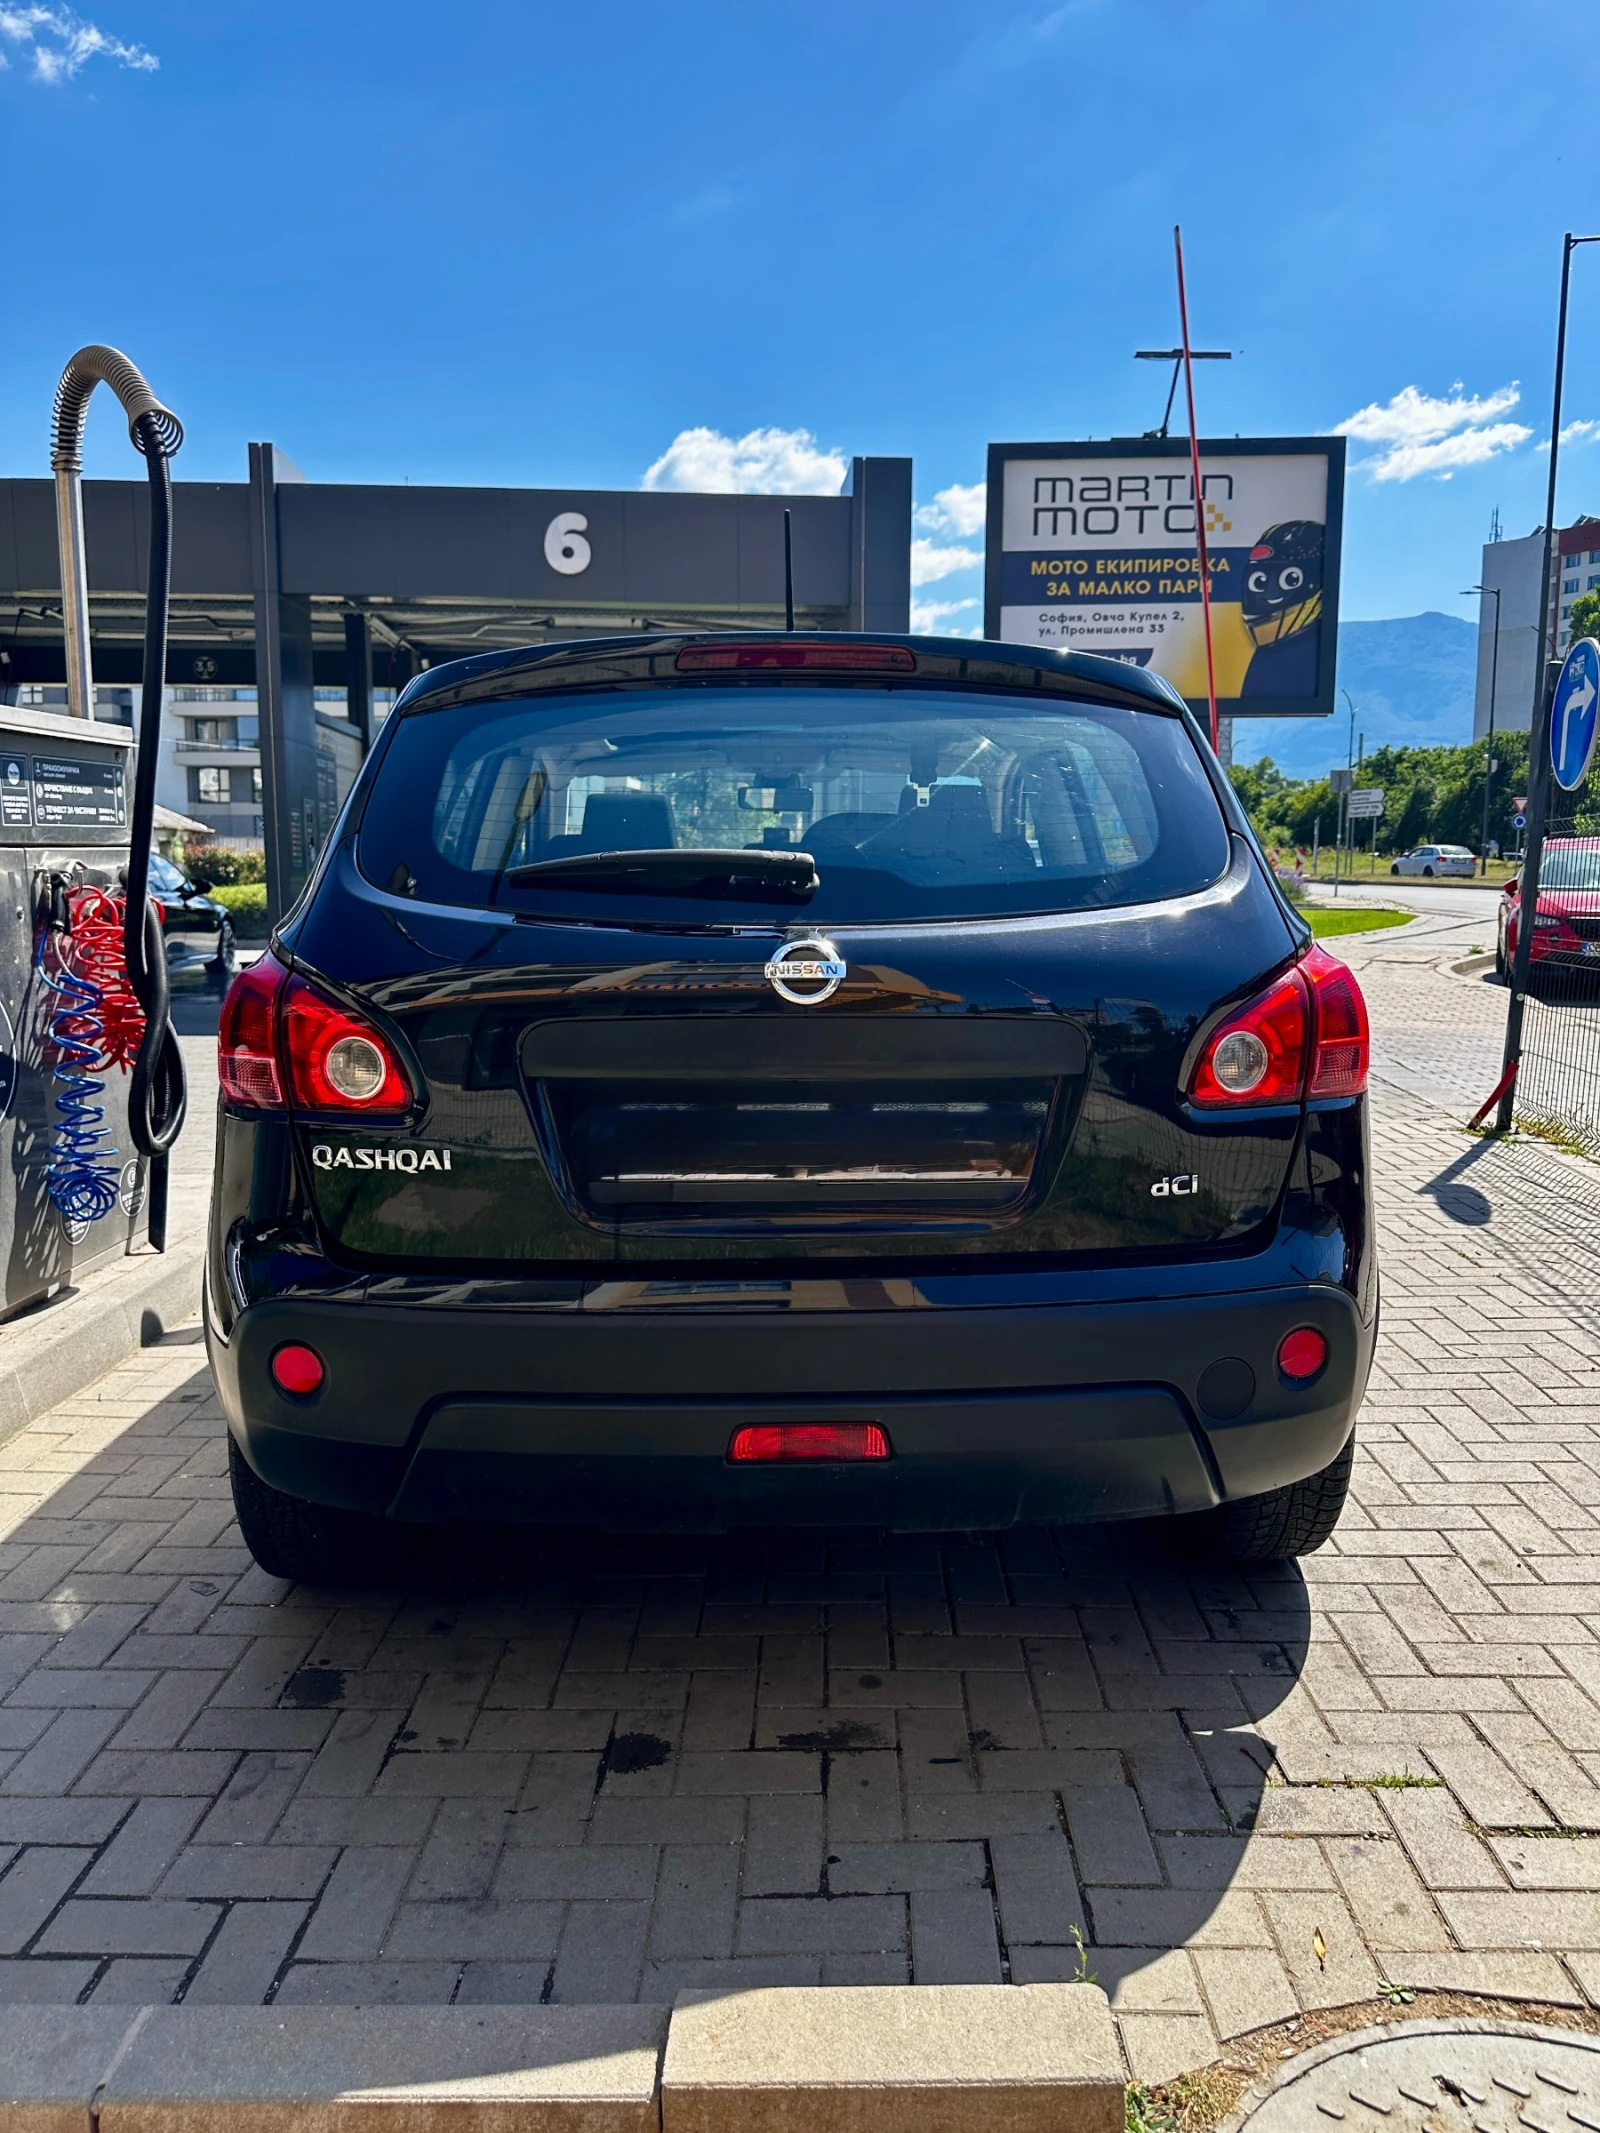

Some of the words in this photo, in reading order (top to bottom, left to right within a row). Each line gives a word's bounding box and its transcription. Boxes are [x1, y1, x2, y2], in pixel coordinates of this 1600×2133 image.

[543, 511, 592, 575] 6
[1031, 560, 1089, 576] МОТО
[1046, 581, 1071, 596] ЗА
[1078, 579, 1151, 596] МАЛКО
[1092, 612, 1125, 623] Овча
[1130, 611, 1168, 624] Купел
[1149, 623, 1166, 634] 33
[773, 964, 838, 976] NISSAN
[312, 1144, 452, 1174] QASHQAI
